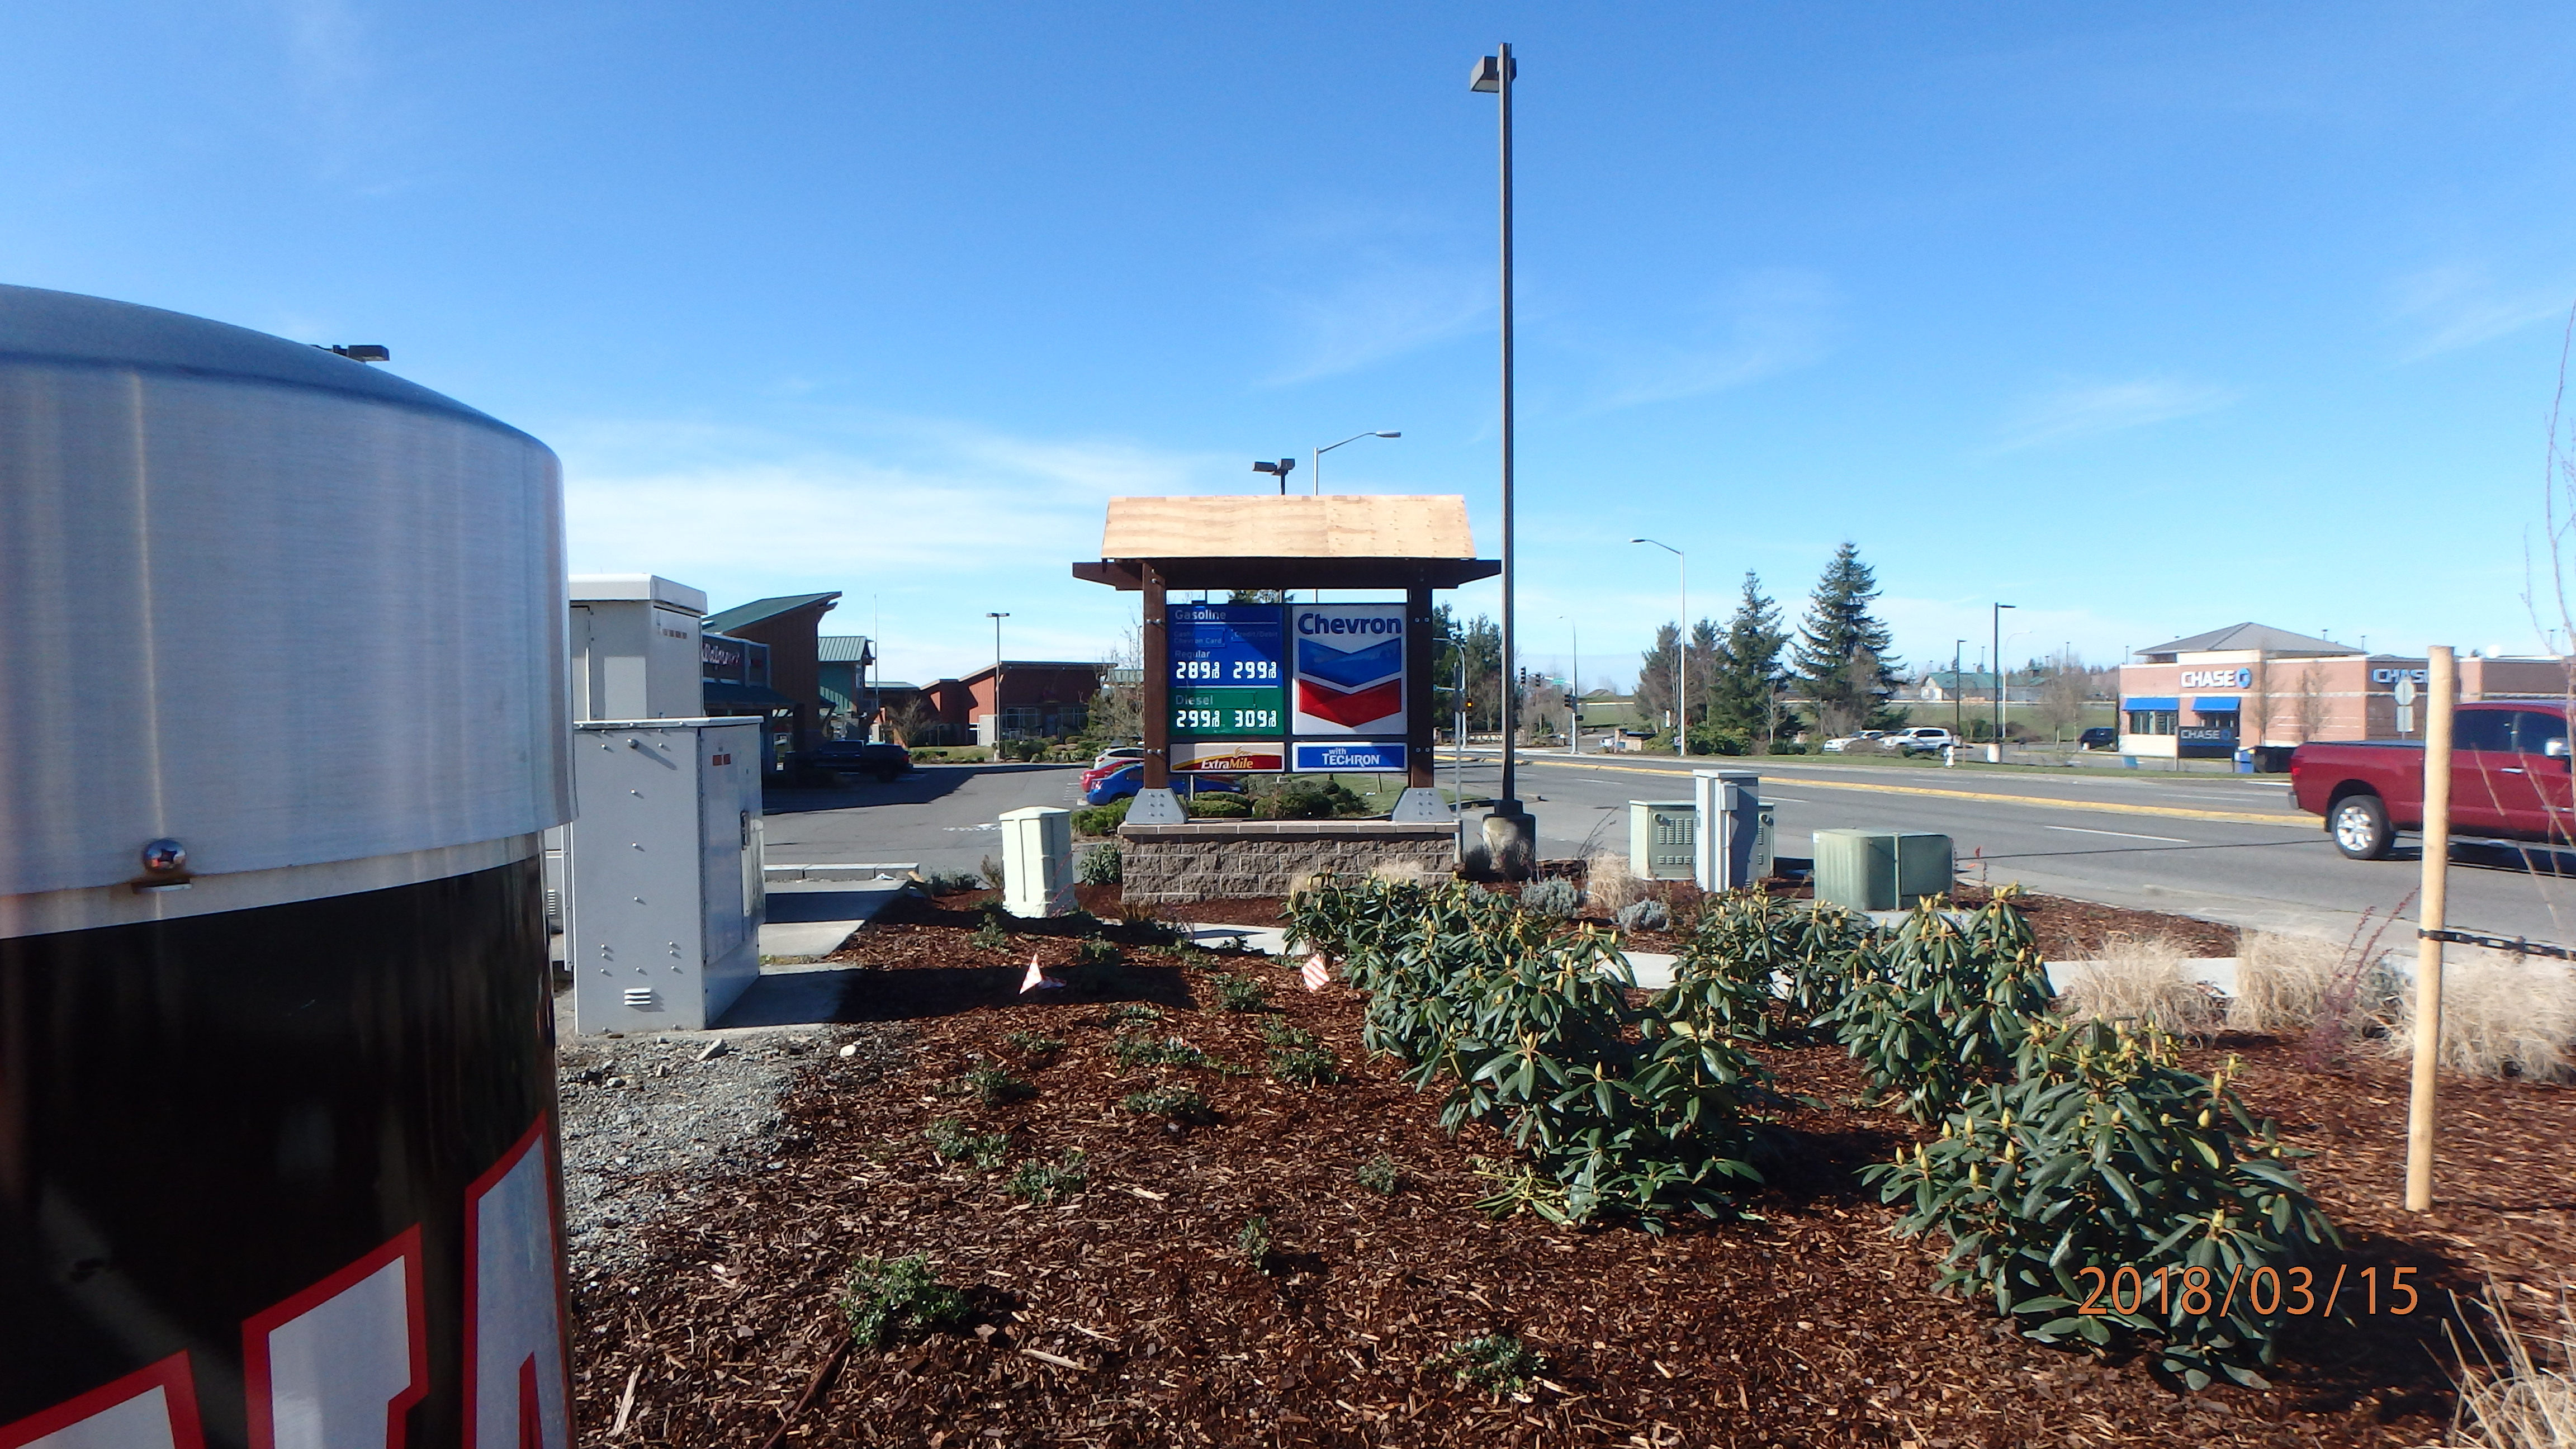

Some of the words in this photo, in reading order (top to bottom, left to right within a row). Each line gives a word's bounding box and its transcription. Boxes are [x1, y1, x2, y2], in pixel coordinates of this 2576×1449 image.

[1175, 609, 1227, 620] Gasoline
[1298, 613, 1402, 635] Chevron
[1175, 650, 1211, 659] Regular
[2181, 670, 2236, 688] CHASE
[2372, 669, 2428, 684] CHAS
[1175, 694, 1214, 705] Diesel
[2181, 729, 2220, 740] CHASE
[1328, 747, 1347, 755] with
[1200, 757, 1254, 770] ExtraMile
[1321, 752, 1380, 768] TECHRON
